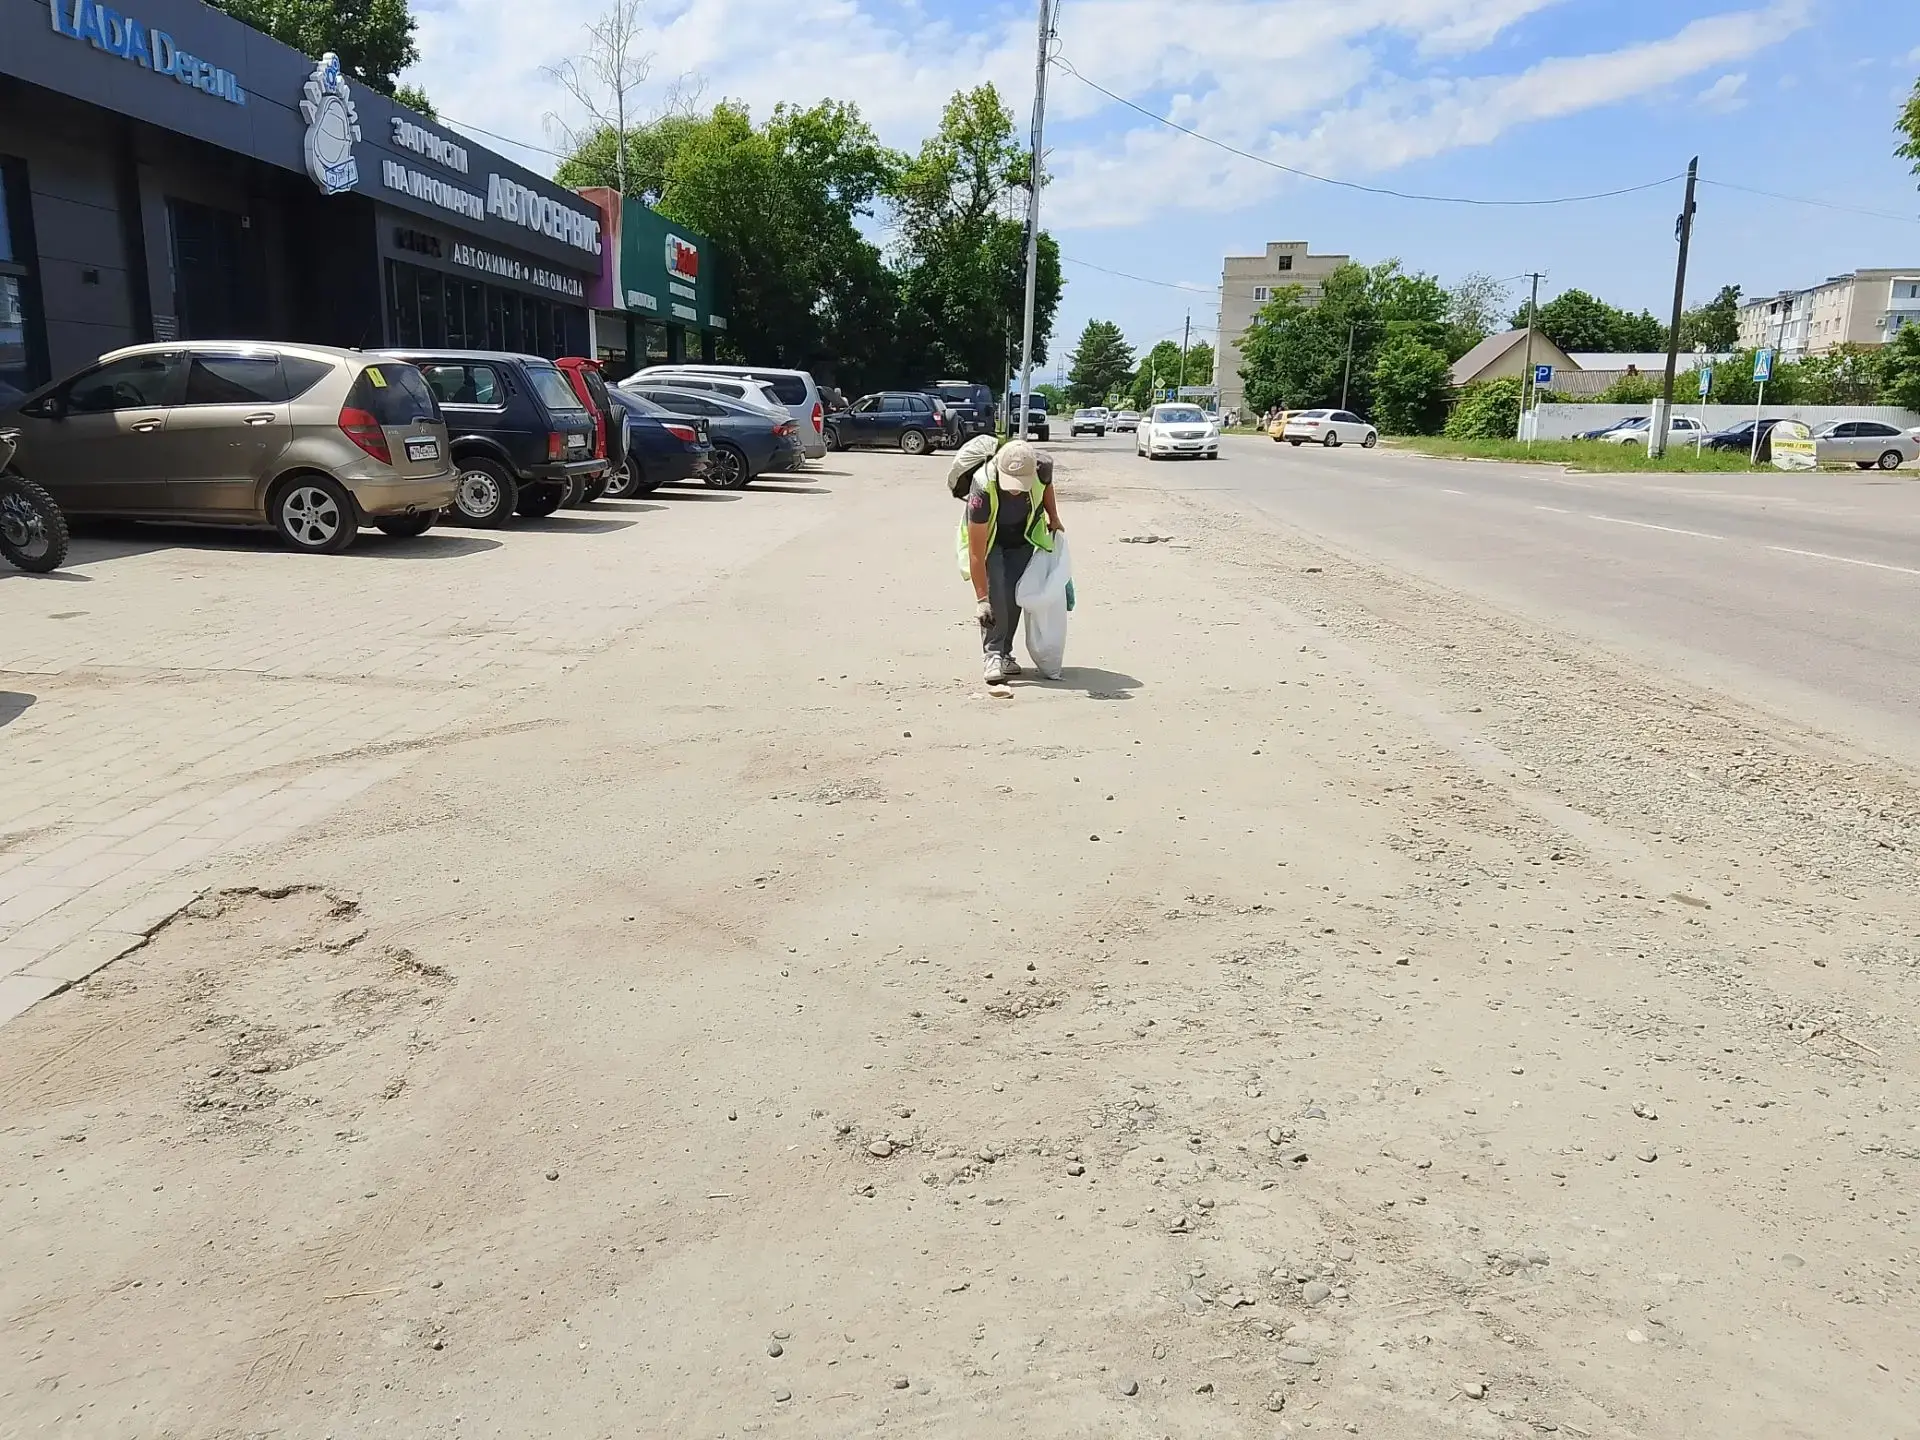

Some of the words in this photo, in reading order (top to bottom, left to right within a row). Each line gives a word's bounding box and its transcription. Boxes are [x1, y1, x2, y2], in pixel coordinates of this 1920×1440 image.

[51, 0, 152, 69] LADA
[391, 117, 469, 174] ЗАПЧАСТИ
[407, 170, 485, 221] ИНОМАРКИ
[486, 173, 602, 256] АВТОСЕРВИС
[453, 242, 520, 280] АВТОХИМИЯ
[532, 267, 584, 297] АВТОМАСЛА
